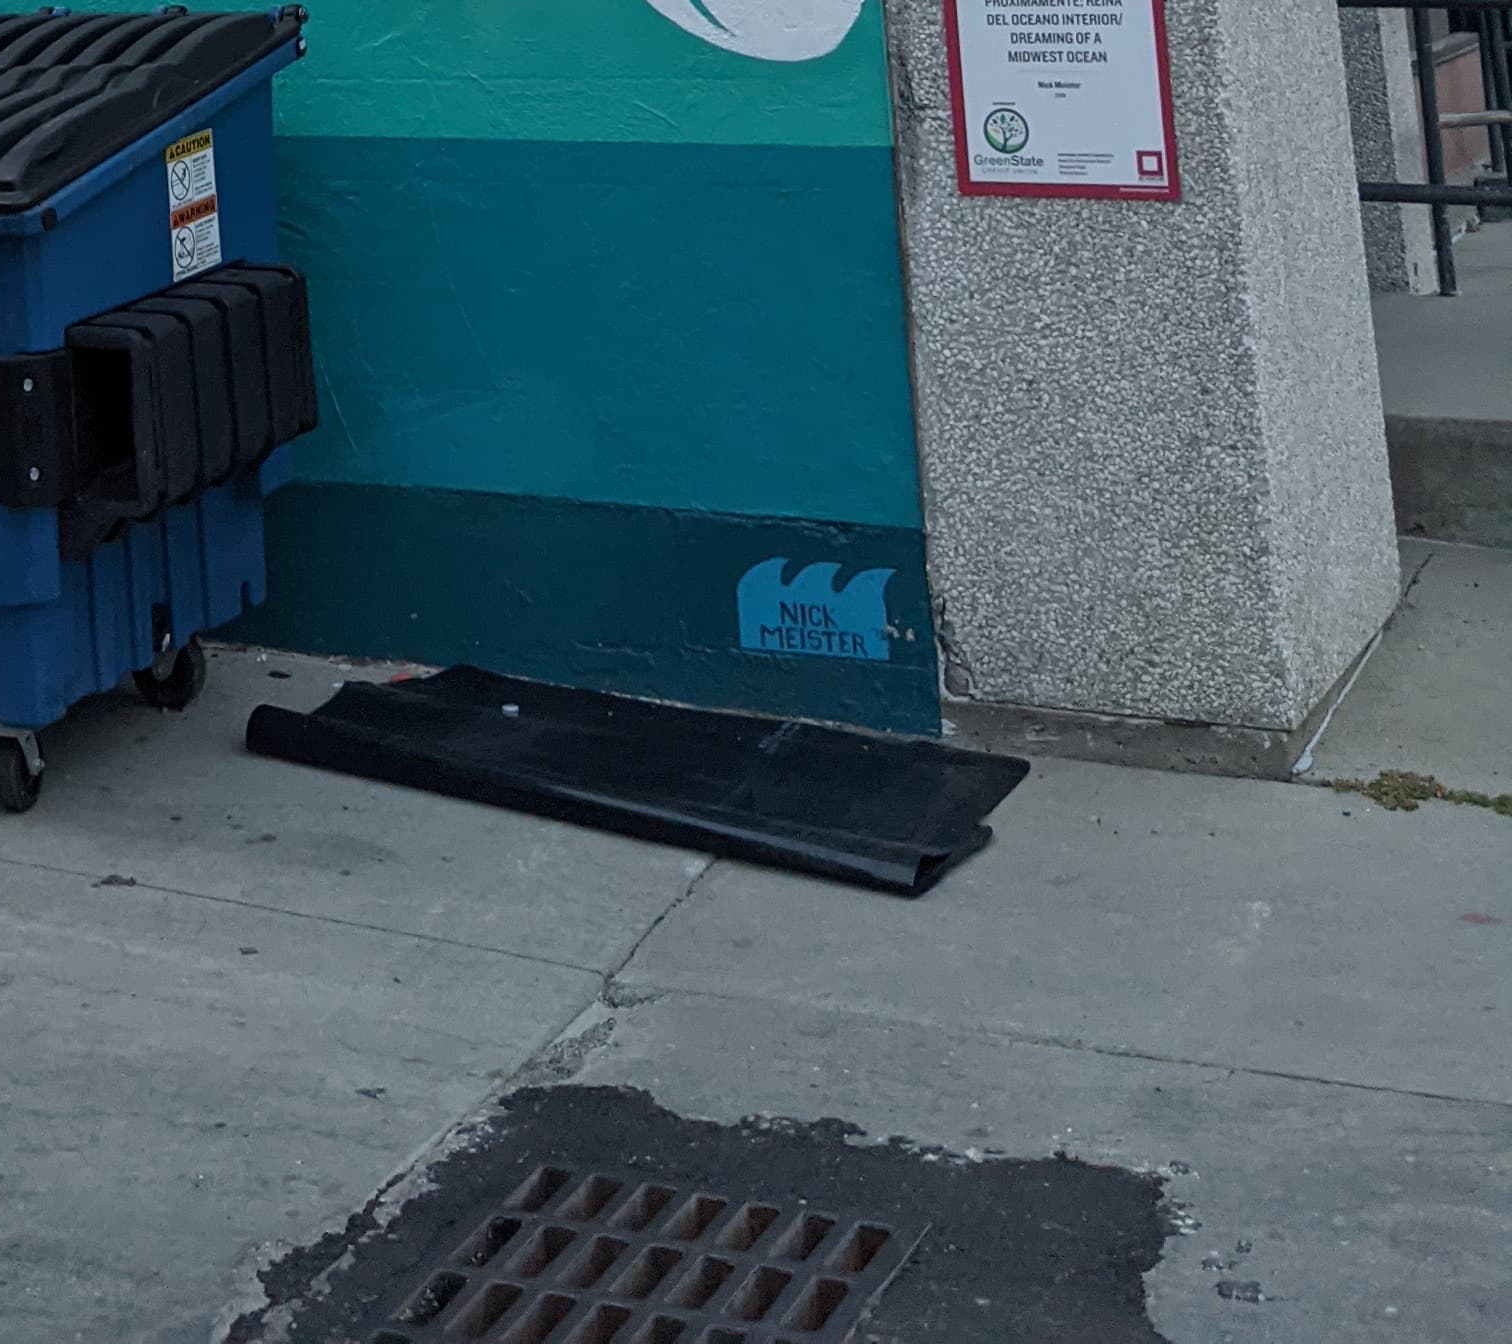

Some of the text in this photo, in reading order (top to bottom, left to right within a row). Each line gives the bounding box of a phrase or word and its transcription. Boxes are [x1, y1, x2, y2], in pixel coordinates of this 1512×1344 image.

[987, 12, 1124, 26] DEL OCEANO INTERIOR/
[1010, 32, 1103, 44] DREAMING OF A
[1008, 50, 1108, 63] MIDWEST OCEAN
[175, 133, 210, 155] CAUTION
[973, 154, 1044, 167] GreenState
[779, 600, 837, 629] NICK
[760, 623, 869, 657] MEISTER
